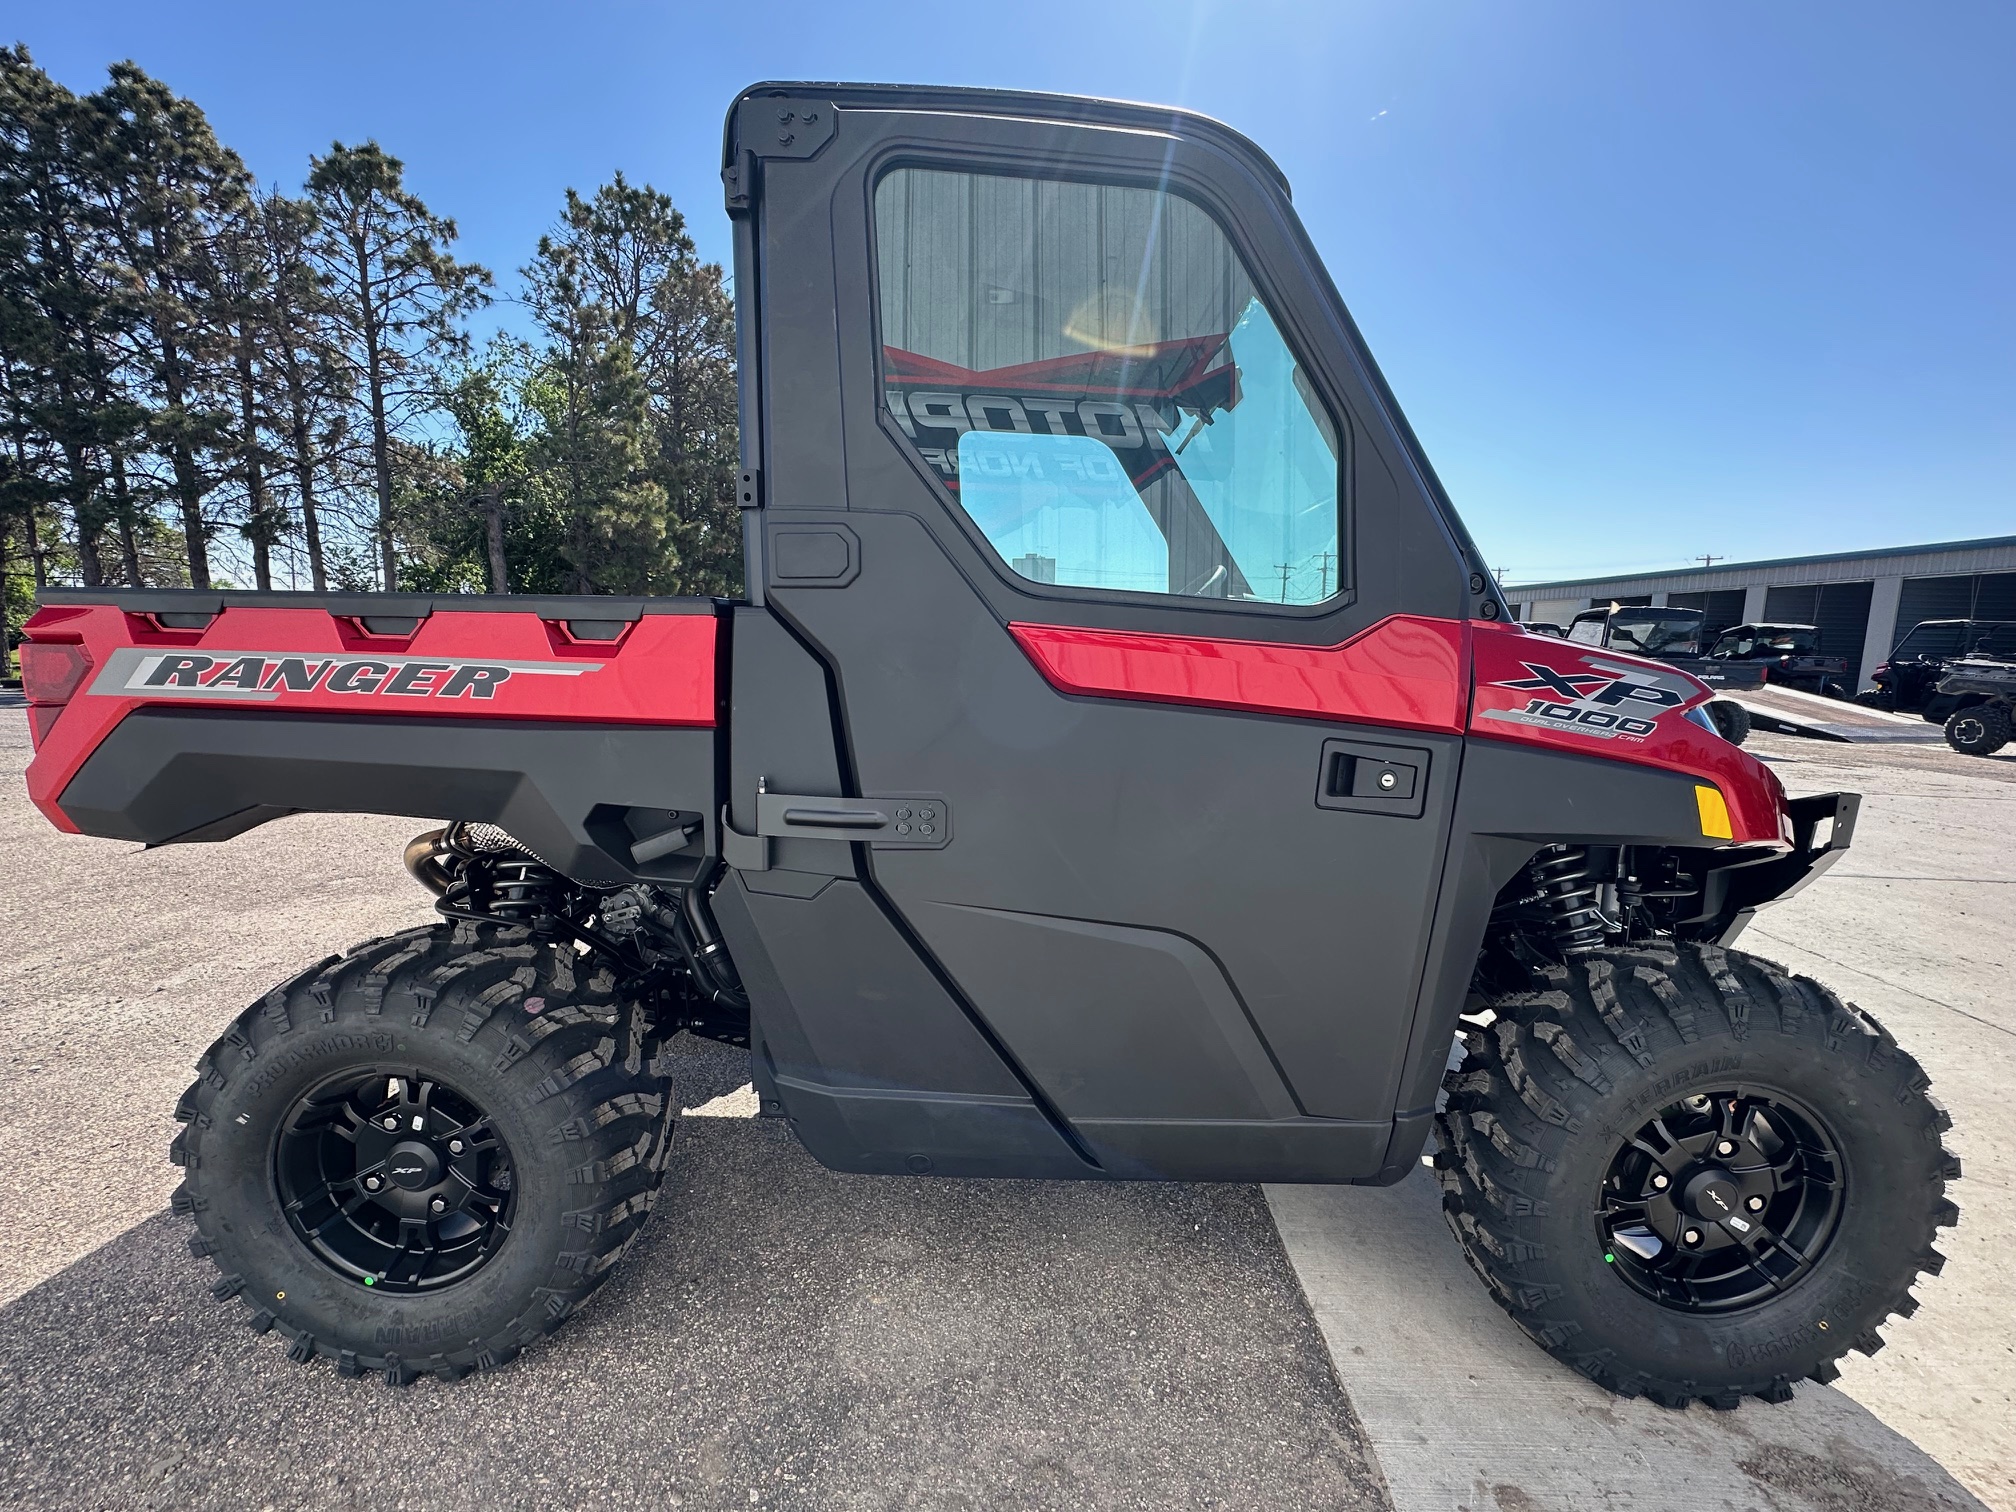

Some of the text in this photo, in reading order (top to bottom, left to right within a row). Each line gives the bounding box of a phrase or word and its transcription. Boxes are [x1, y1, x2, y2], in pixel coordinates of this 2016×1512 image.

[143, 653, 512, 700] RANGER
[1489, 660, 1686, 709] XP
[1520, 715, 1645, 744] DUAL OVERHEAD CAM
[1524, 698, 1658, 737] 1000
[245, 1033, 369, 1098] PRO ARMOR
[1597, 1055, 1743, 1144] X-TERRAIN
[1705, 1189, 1729, 1211] XP
